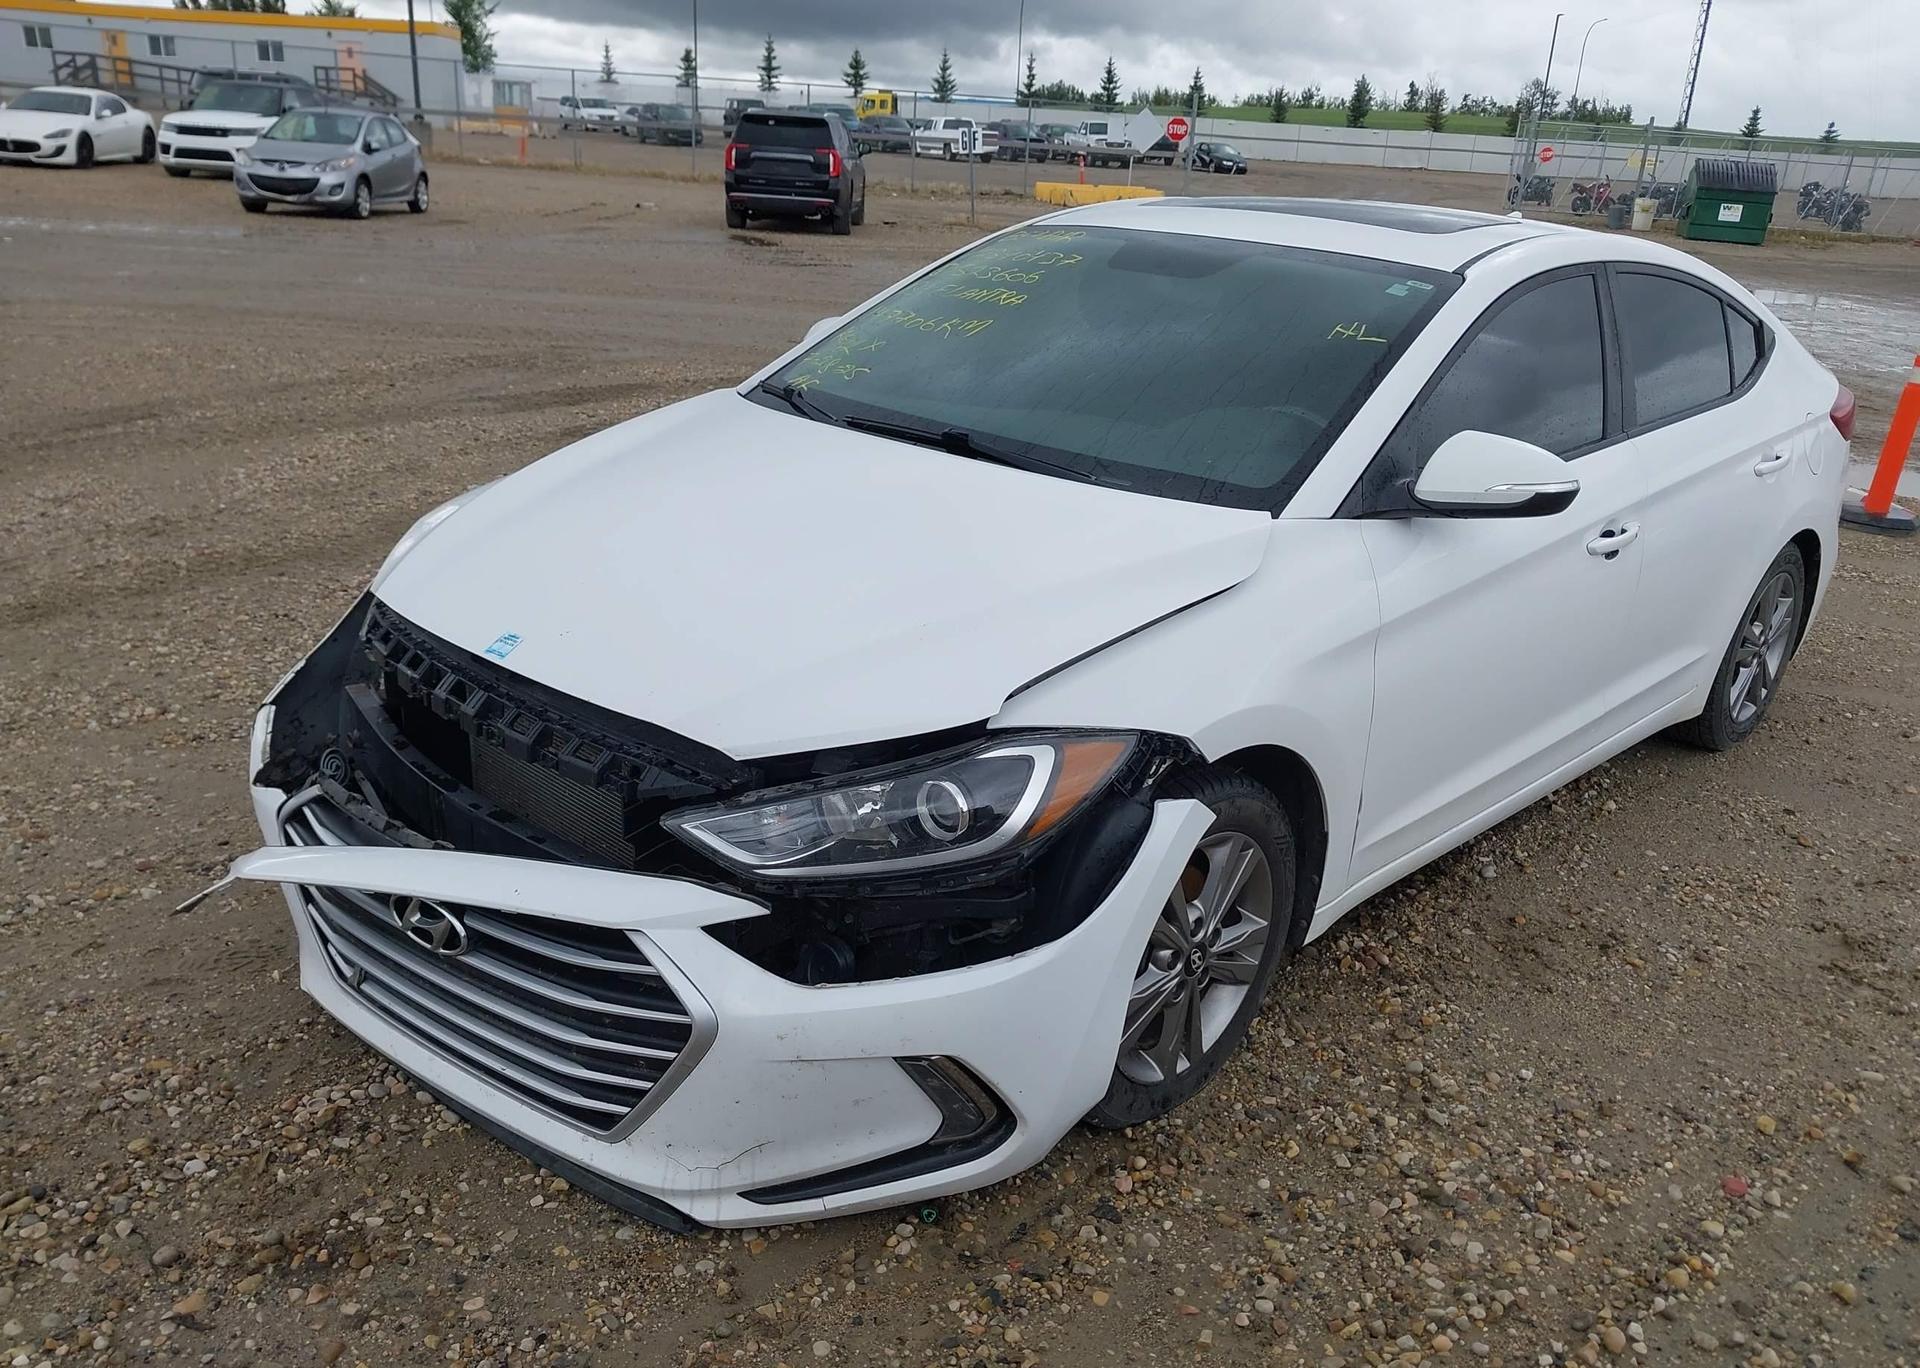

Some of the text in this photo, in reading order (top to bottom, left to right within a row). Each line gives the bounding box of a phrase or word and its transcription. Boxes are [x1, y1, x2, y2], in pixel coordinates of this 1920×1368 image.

[1168, 124, 1187, 135] STOP
[961, 130, 968, 151] G
[972, 130, 979, 151] F
